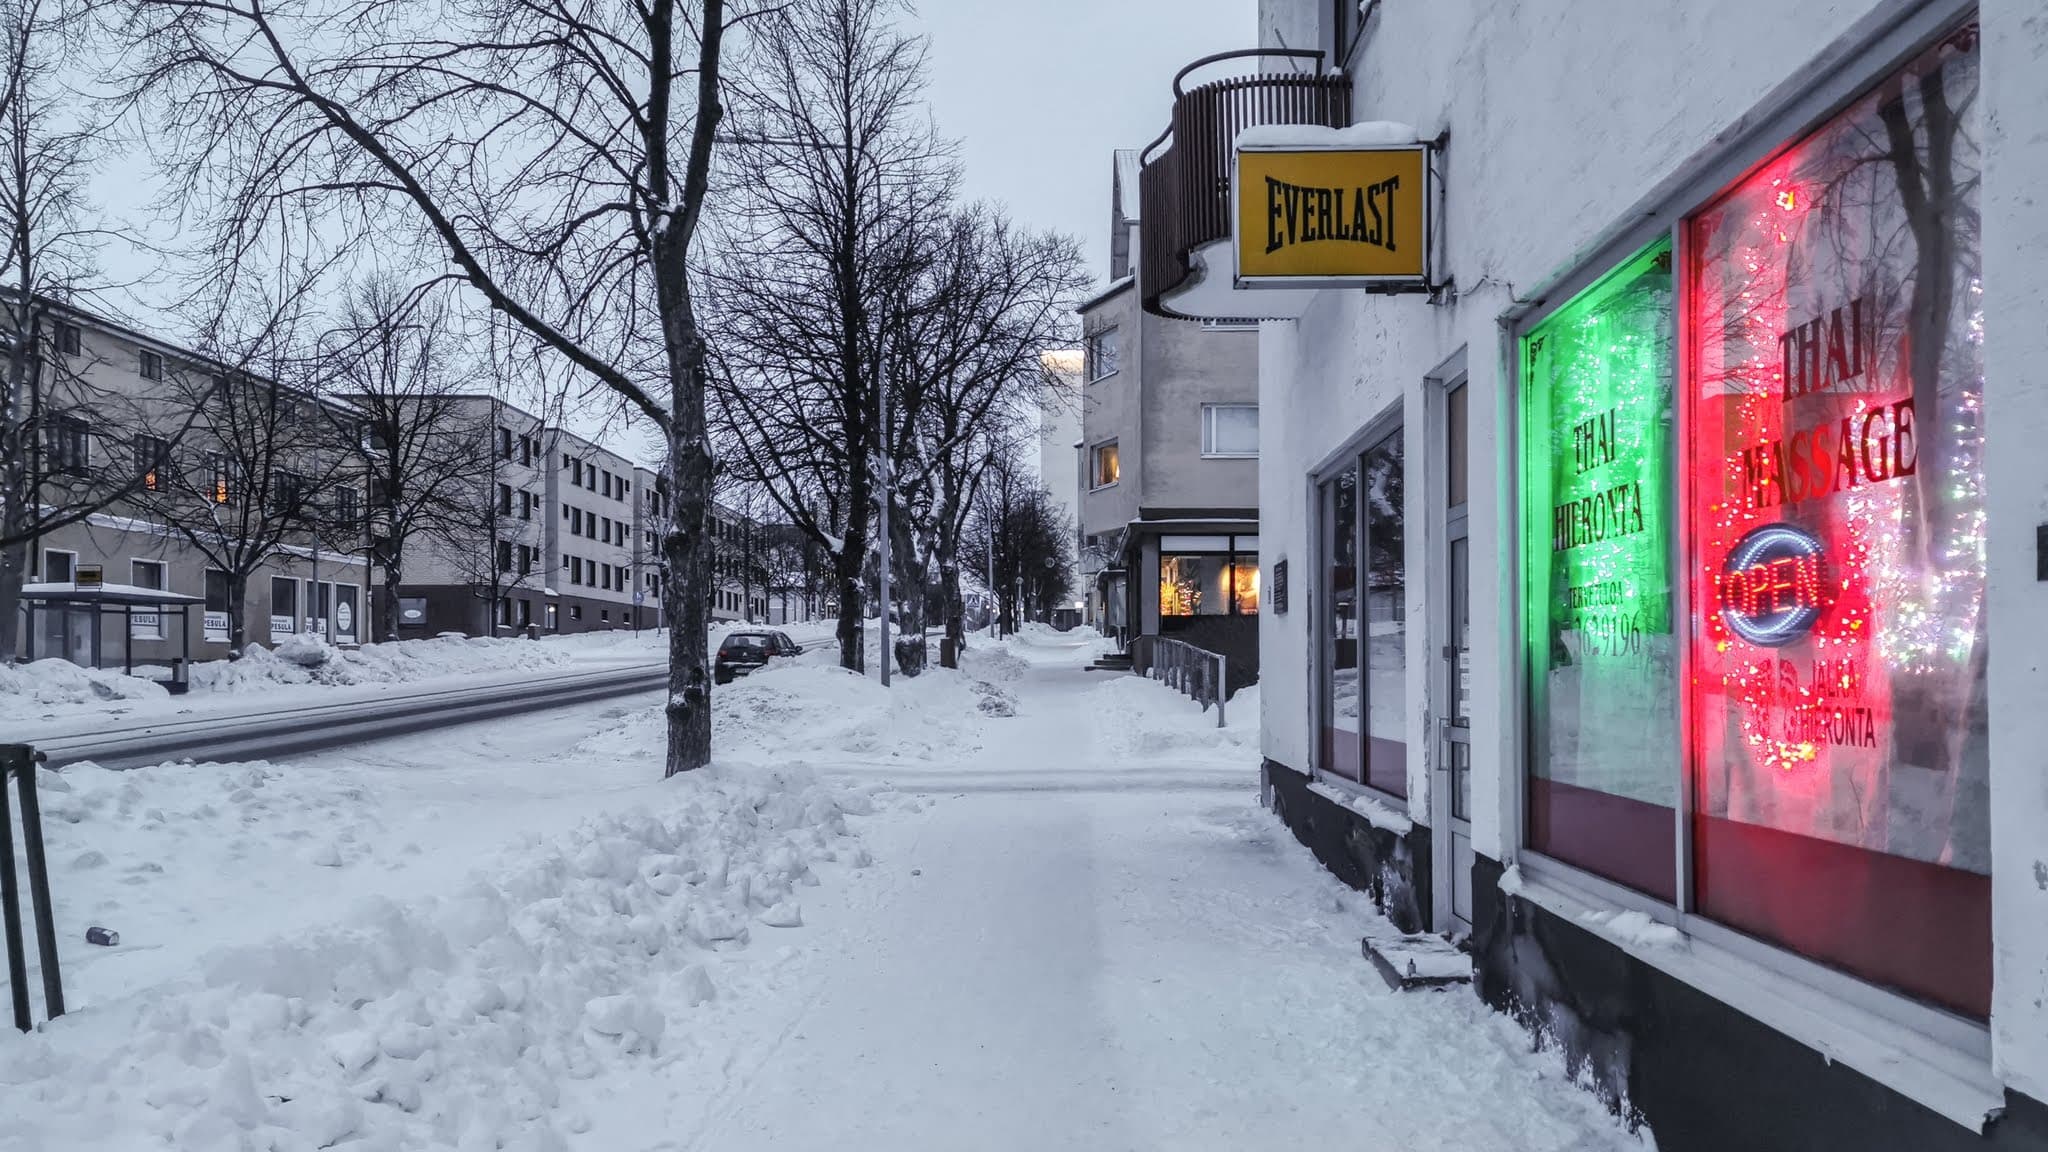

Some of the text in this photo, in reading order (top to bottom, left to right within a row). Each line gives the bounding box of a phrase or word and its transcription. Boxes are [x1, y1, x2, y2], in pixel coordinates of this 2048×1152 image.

[1265, 175, 1399, 254] EVERLAST
[1778, 298, 1863, 402] THAI
[1574, 408, 1616, 475] THAI
[1742, 398, 1918, 508] MASSAGE
[1553, 480, 1644, 552] HIERONTA
[1726, 552, 1818, 617] OPEN
